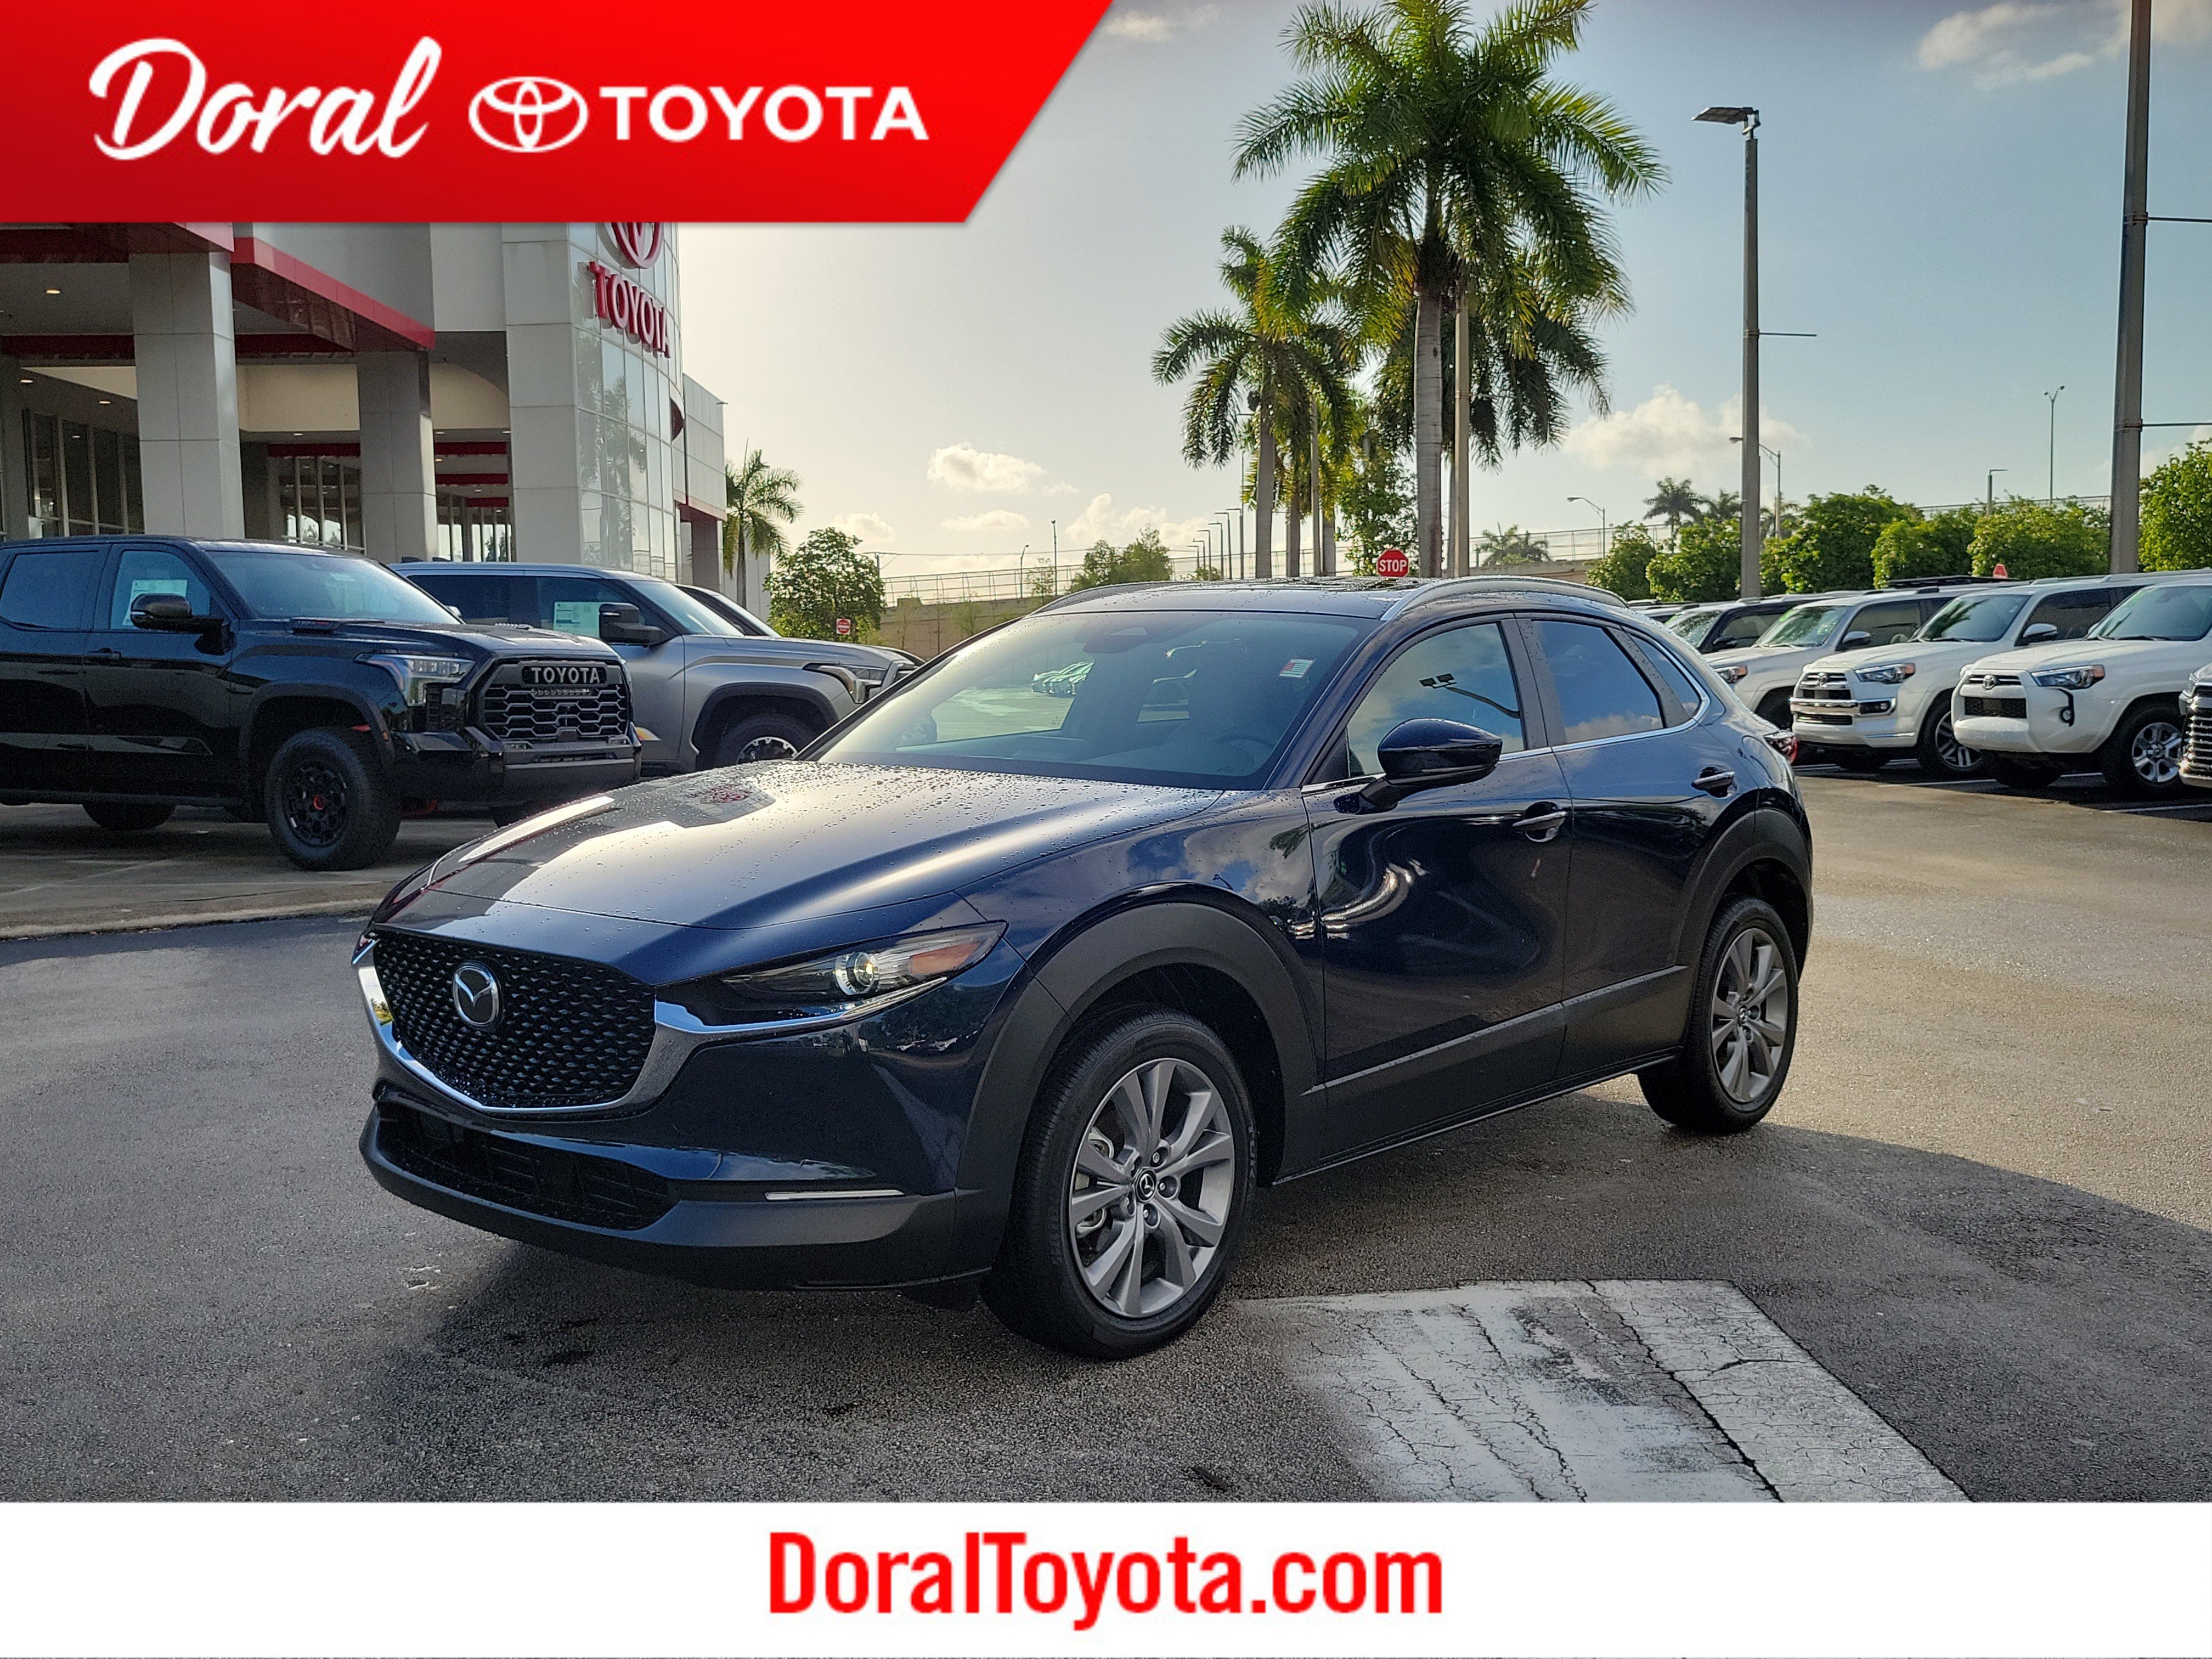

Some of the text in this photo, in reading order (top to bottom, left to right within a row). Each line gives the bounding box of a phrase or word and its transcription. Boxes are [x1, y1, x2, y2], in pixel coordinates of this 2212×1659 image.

[589, 261, 671, 358] TOYOTA
[1379, 560, 1407, 572] STOP
[531, 667, 600, 684] TOYOTA
